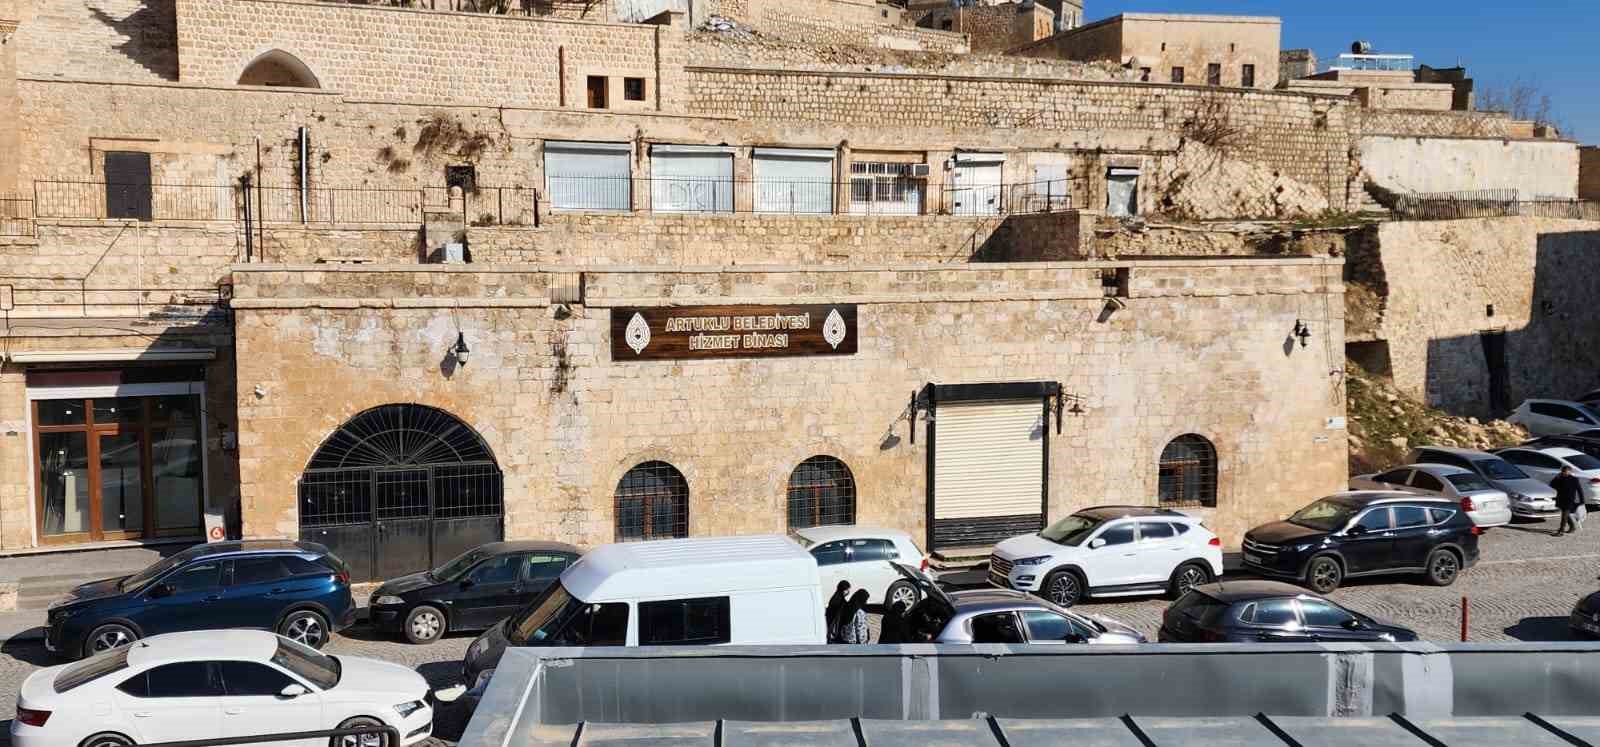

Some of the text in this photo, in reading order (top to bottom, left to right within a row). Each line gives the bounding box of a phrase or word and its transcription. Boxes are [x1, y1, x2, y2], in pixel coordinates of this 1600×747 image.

[665, 312, 810, 331] ARTUKLU BELEDİYESİ
[689, 332, 789, 350] HİZMET BİNASI
